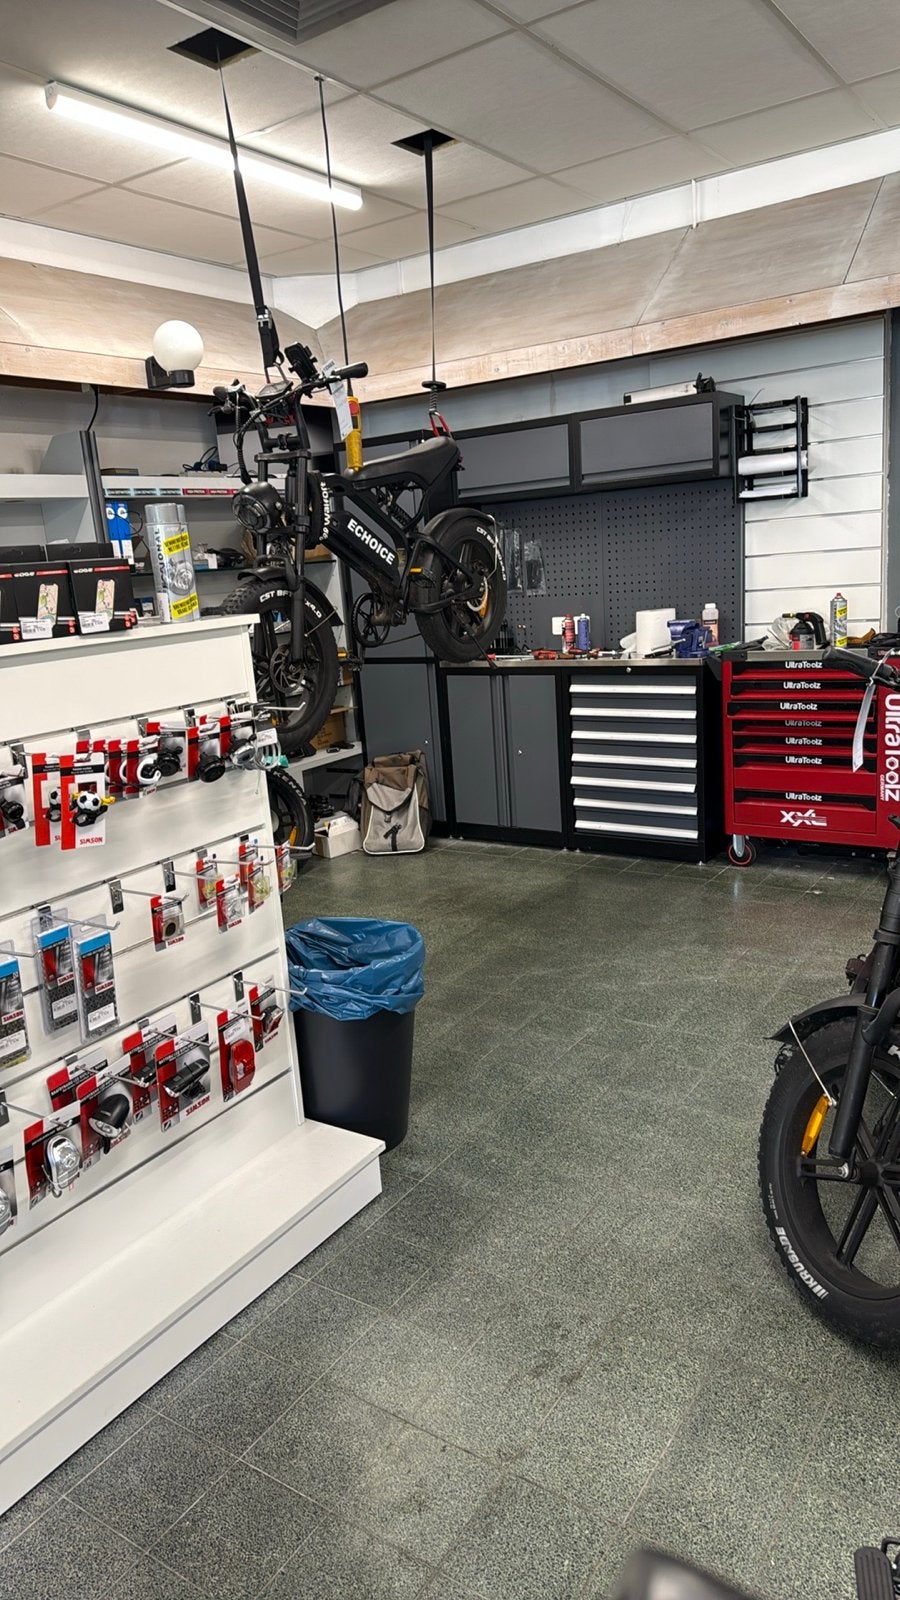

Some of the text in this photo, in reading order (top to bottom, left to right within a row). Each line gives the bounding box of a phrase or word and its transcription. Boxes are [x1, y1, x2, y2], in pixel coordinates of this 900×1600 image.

[347, 518, 396, 566] ECHOICE
[259, 590, 276, 603] CST
[785, 660, 823, 670] UltraToolz
[783, 681, 821, 690] UltraToolz
[780, 702, 818, 711] UltraToolz
[785, 737, 823, 746] UltraToolz
[785, 756, 823, 765] UltraToolz
[785, 792, 823, 802] UltraToolz
[780, 808, 828, 827] XXL
[79, 837, 103, 845] SIMSON
[185, 1096, 210, 1116] SIMSON
